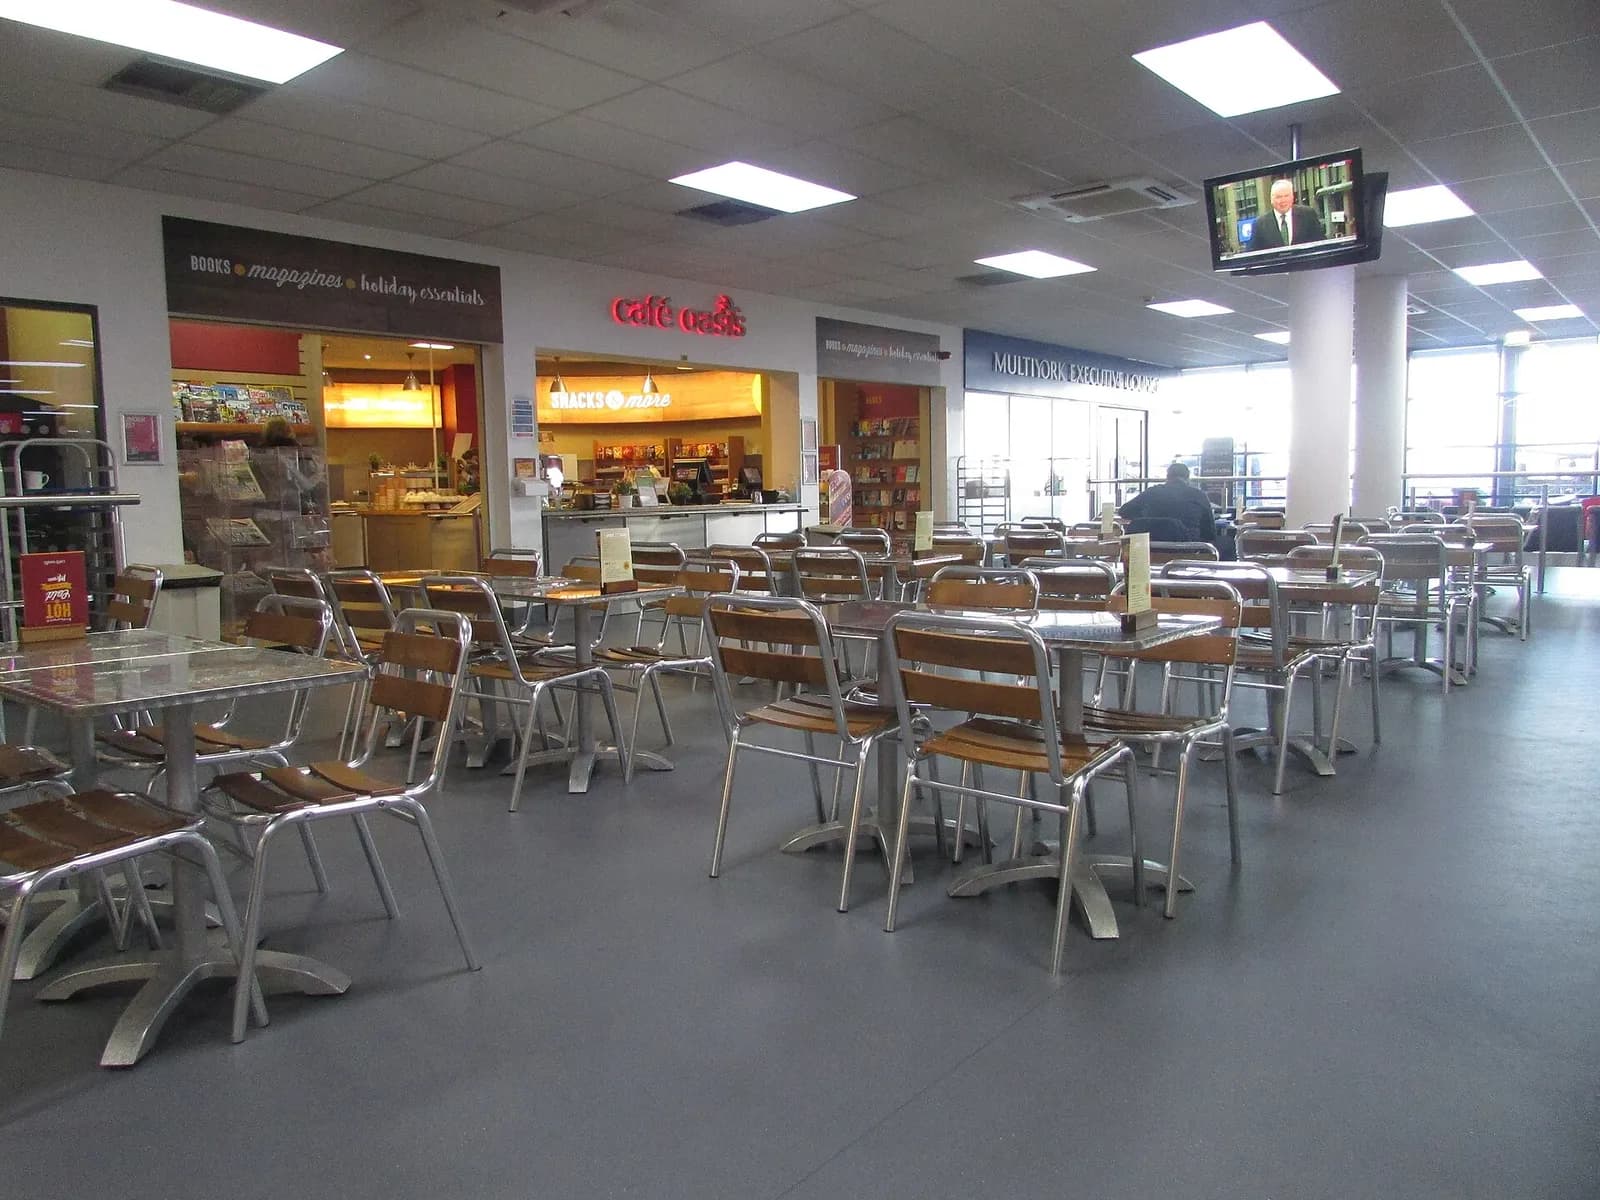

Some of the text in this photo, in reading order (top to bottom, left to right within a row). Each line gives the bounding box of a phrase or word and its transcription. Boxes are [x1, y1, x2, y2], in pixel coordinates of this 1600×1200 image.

[190, 255, 485, 305] BOOKS magazines holiday essentials
[993, 351, 1066, 382] MULTIYORK
[1069, 363, 1123, 388] EXECUTIVE
[551, 391, 604, 409] SNACKS
[624, 393, 672, 409] more
[45, 589, 71, 602] Cold
[46, 602, 71, 619] HOT
